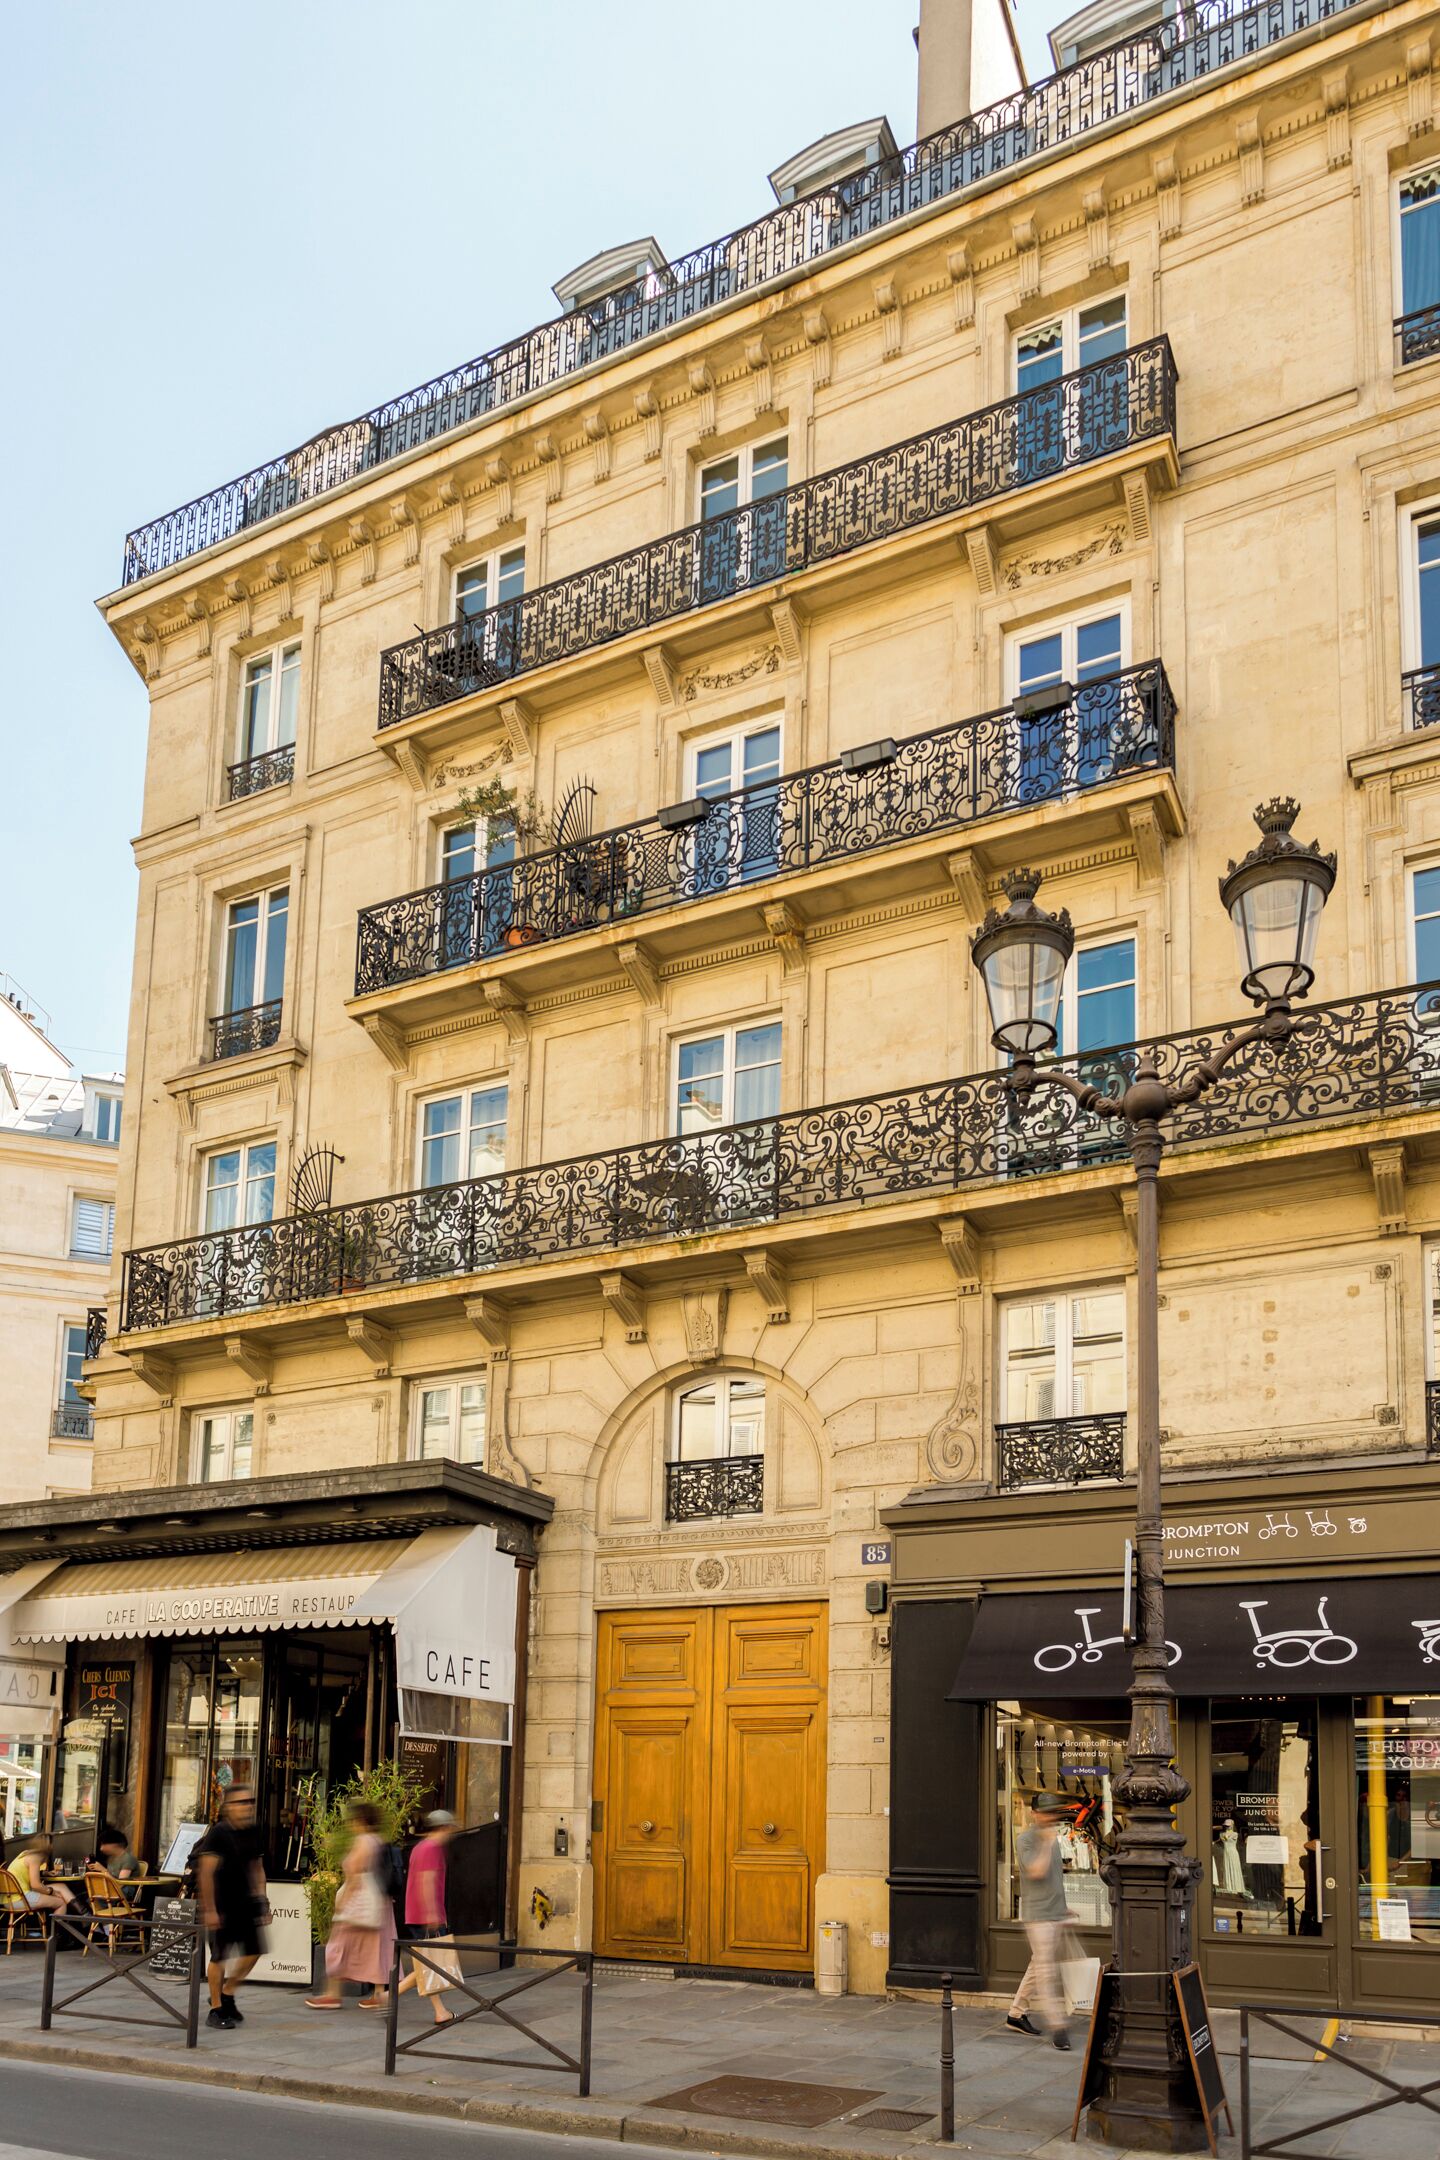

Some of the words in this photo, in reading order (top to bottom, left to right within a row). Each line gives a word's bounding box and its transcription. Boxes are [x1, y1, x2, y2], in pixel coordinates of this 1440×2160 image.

[866, 1544, 887, 1562] 85
[1167, 1545, 1240, 1560] JUNCTION
[106, 1609, 136, 1625] CAFE
[148, 1600, 167, 1623] LA
[170, 1594, 279, 1620] COOPERATIVE
[292, 1594, 358, 1613] RESTAUR
[105, 1667, 131, 1682] CLIENTS
[426, 1650, 490, 1690] CAFE
[404, 1741, 438, 1753] DESSERTS
[1065, 1740, 1105, 1750] Brompton
[1368, 1740, 1406, 1753] THE
[1061, 1750, 1096, 1759] powered
[1098, 1750, 1108, 1759] by
[1387, 1756, 1427, 1769] YOU
[1072, 1767, 1097, 1775] e-Motiq
[1240, 1796, 1290, 1804] BROMPTO
[270, 1908, 300, 1919] ATIVE
[270, 1961, 307, 1974] Schweppes
